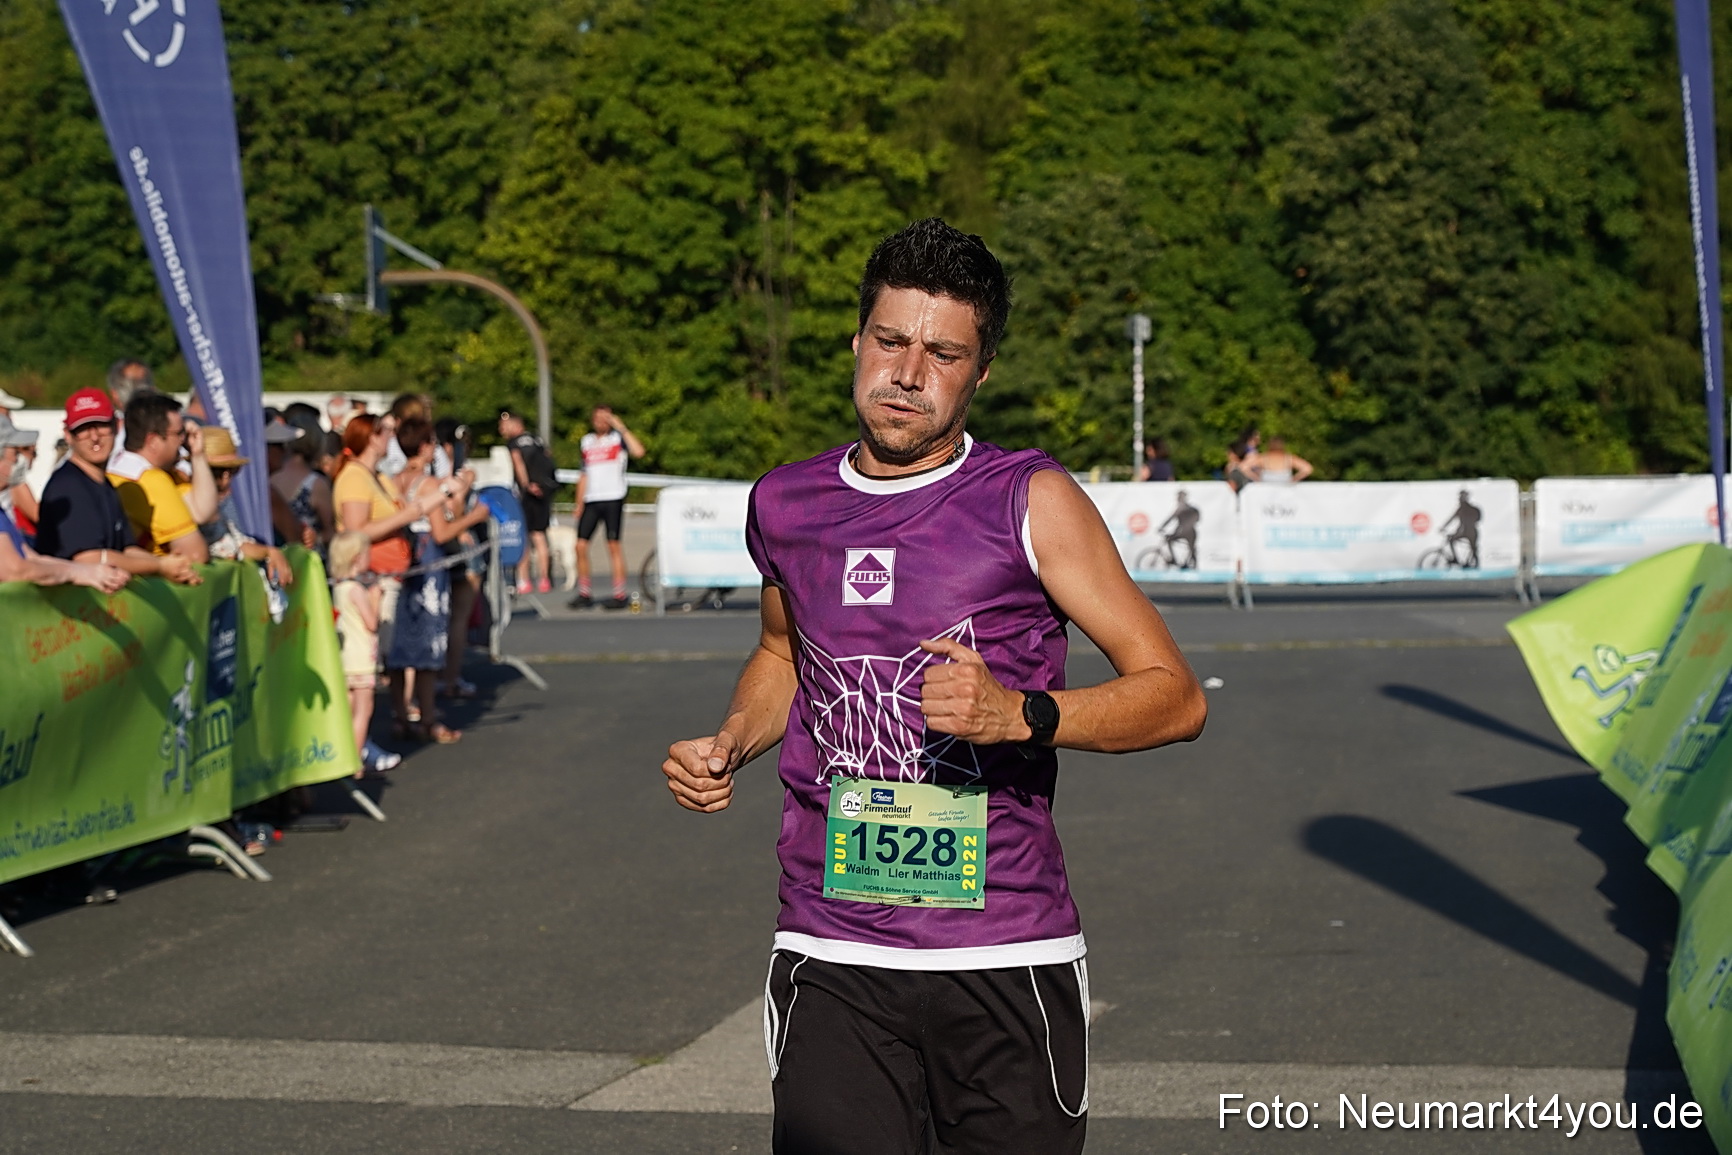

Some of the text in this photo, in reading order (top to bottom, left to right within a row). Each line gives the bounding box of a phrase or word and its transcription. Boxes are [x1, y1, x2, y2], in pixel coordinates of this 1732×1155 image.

[846, 571, 891, 582] FUCHS
[863, 803, 913, 814] Firmenlauf
[834, 833, 846, 875] RUN
[851, 822, 957, 867] 1528
[846, 863, 880, 876] Waldm
[912, 869, 961, 882] Matthias
[962, 835, 977, 890] 2022
